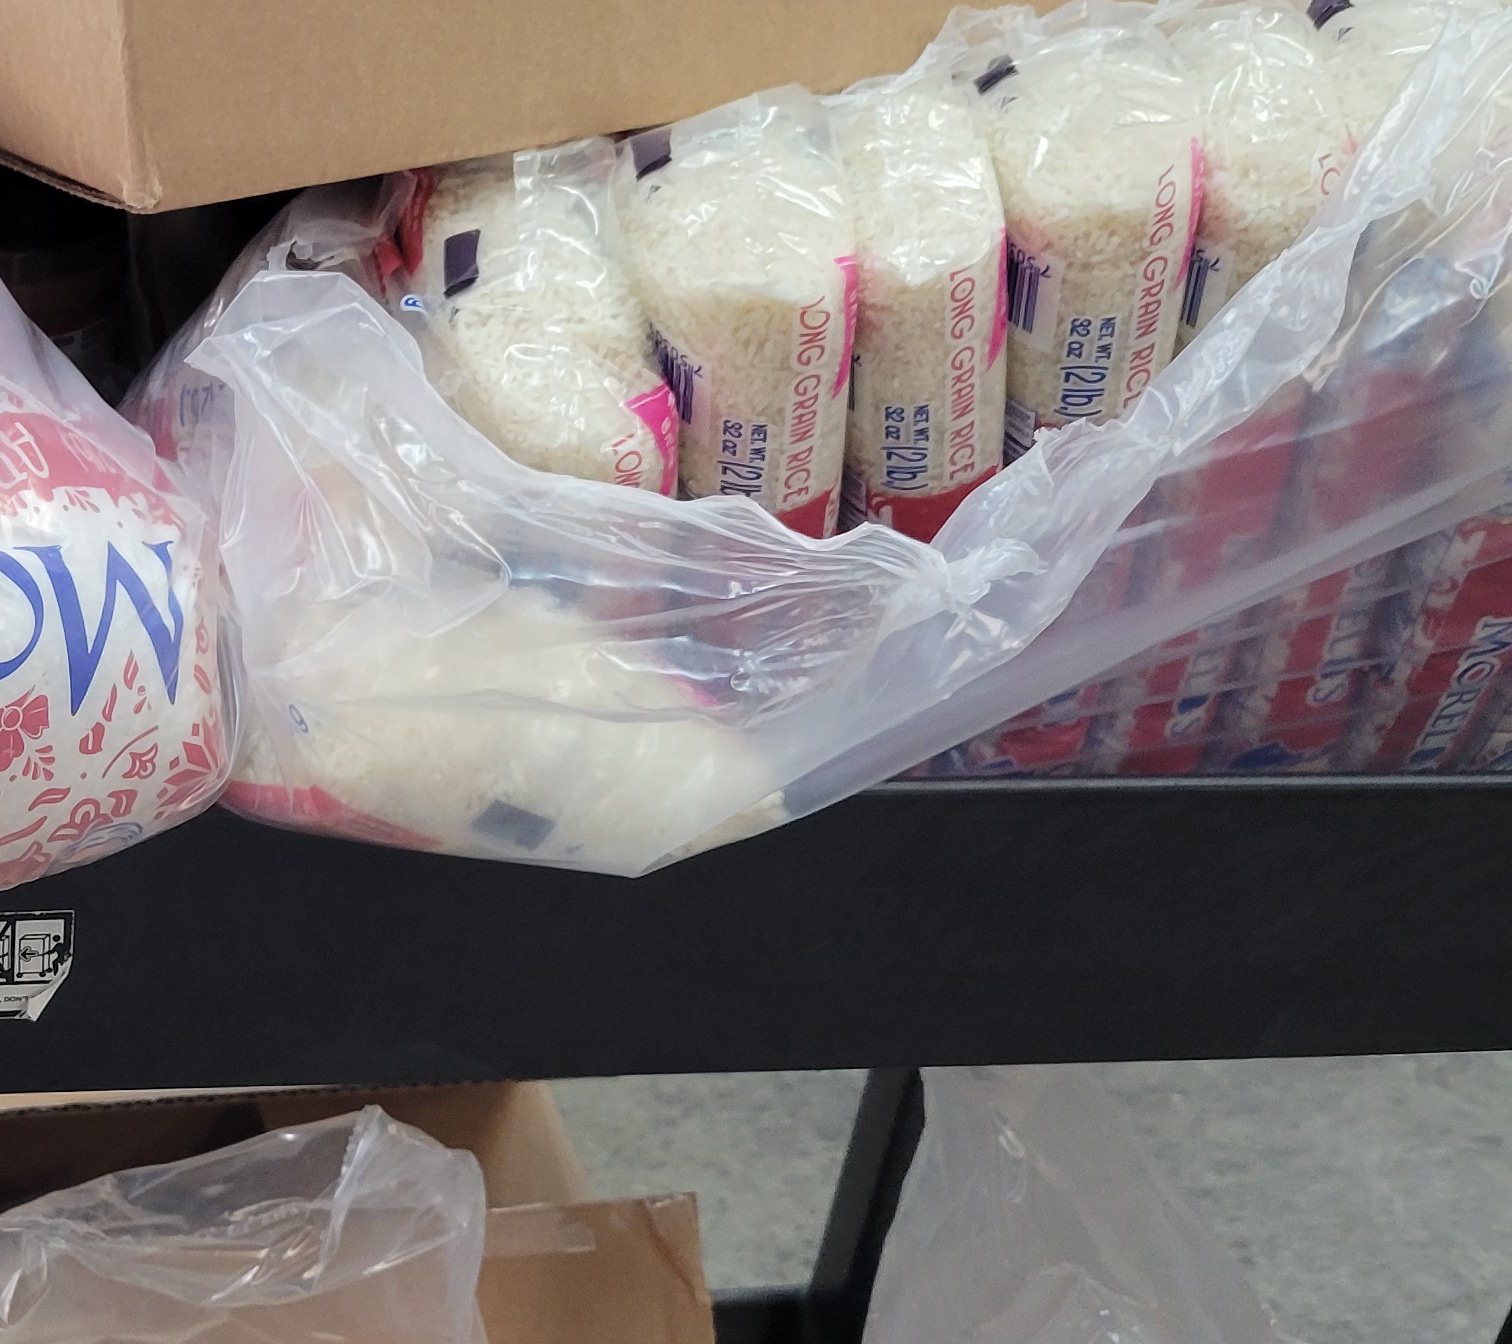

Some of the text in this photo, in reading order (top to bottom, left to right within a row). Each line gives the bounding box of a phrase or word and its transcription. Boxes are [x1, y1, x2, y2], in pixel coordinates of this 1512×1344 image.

[1135, 164, 1177, 340] LONG GRAIN
[1068, 317, 1093, 338] 32
[1096, 316, 1117, 342] NET.
[948, 268, 977, 482] LONG GRAIN RICE
[781, 295, 832, 504] LONG GRAIN RICE
[884, 406, 905, 424] 32
[722, 418, 743, 439] 32
[750, 423, 769, 444] NET.
